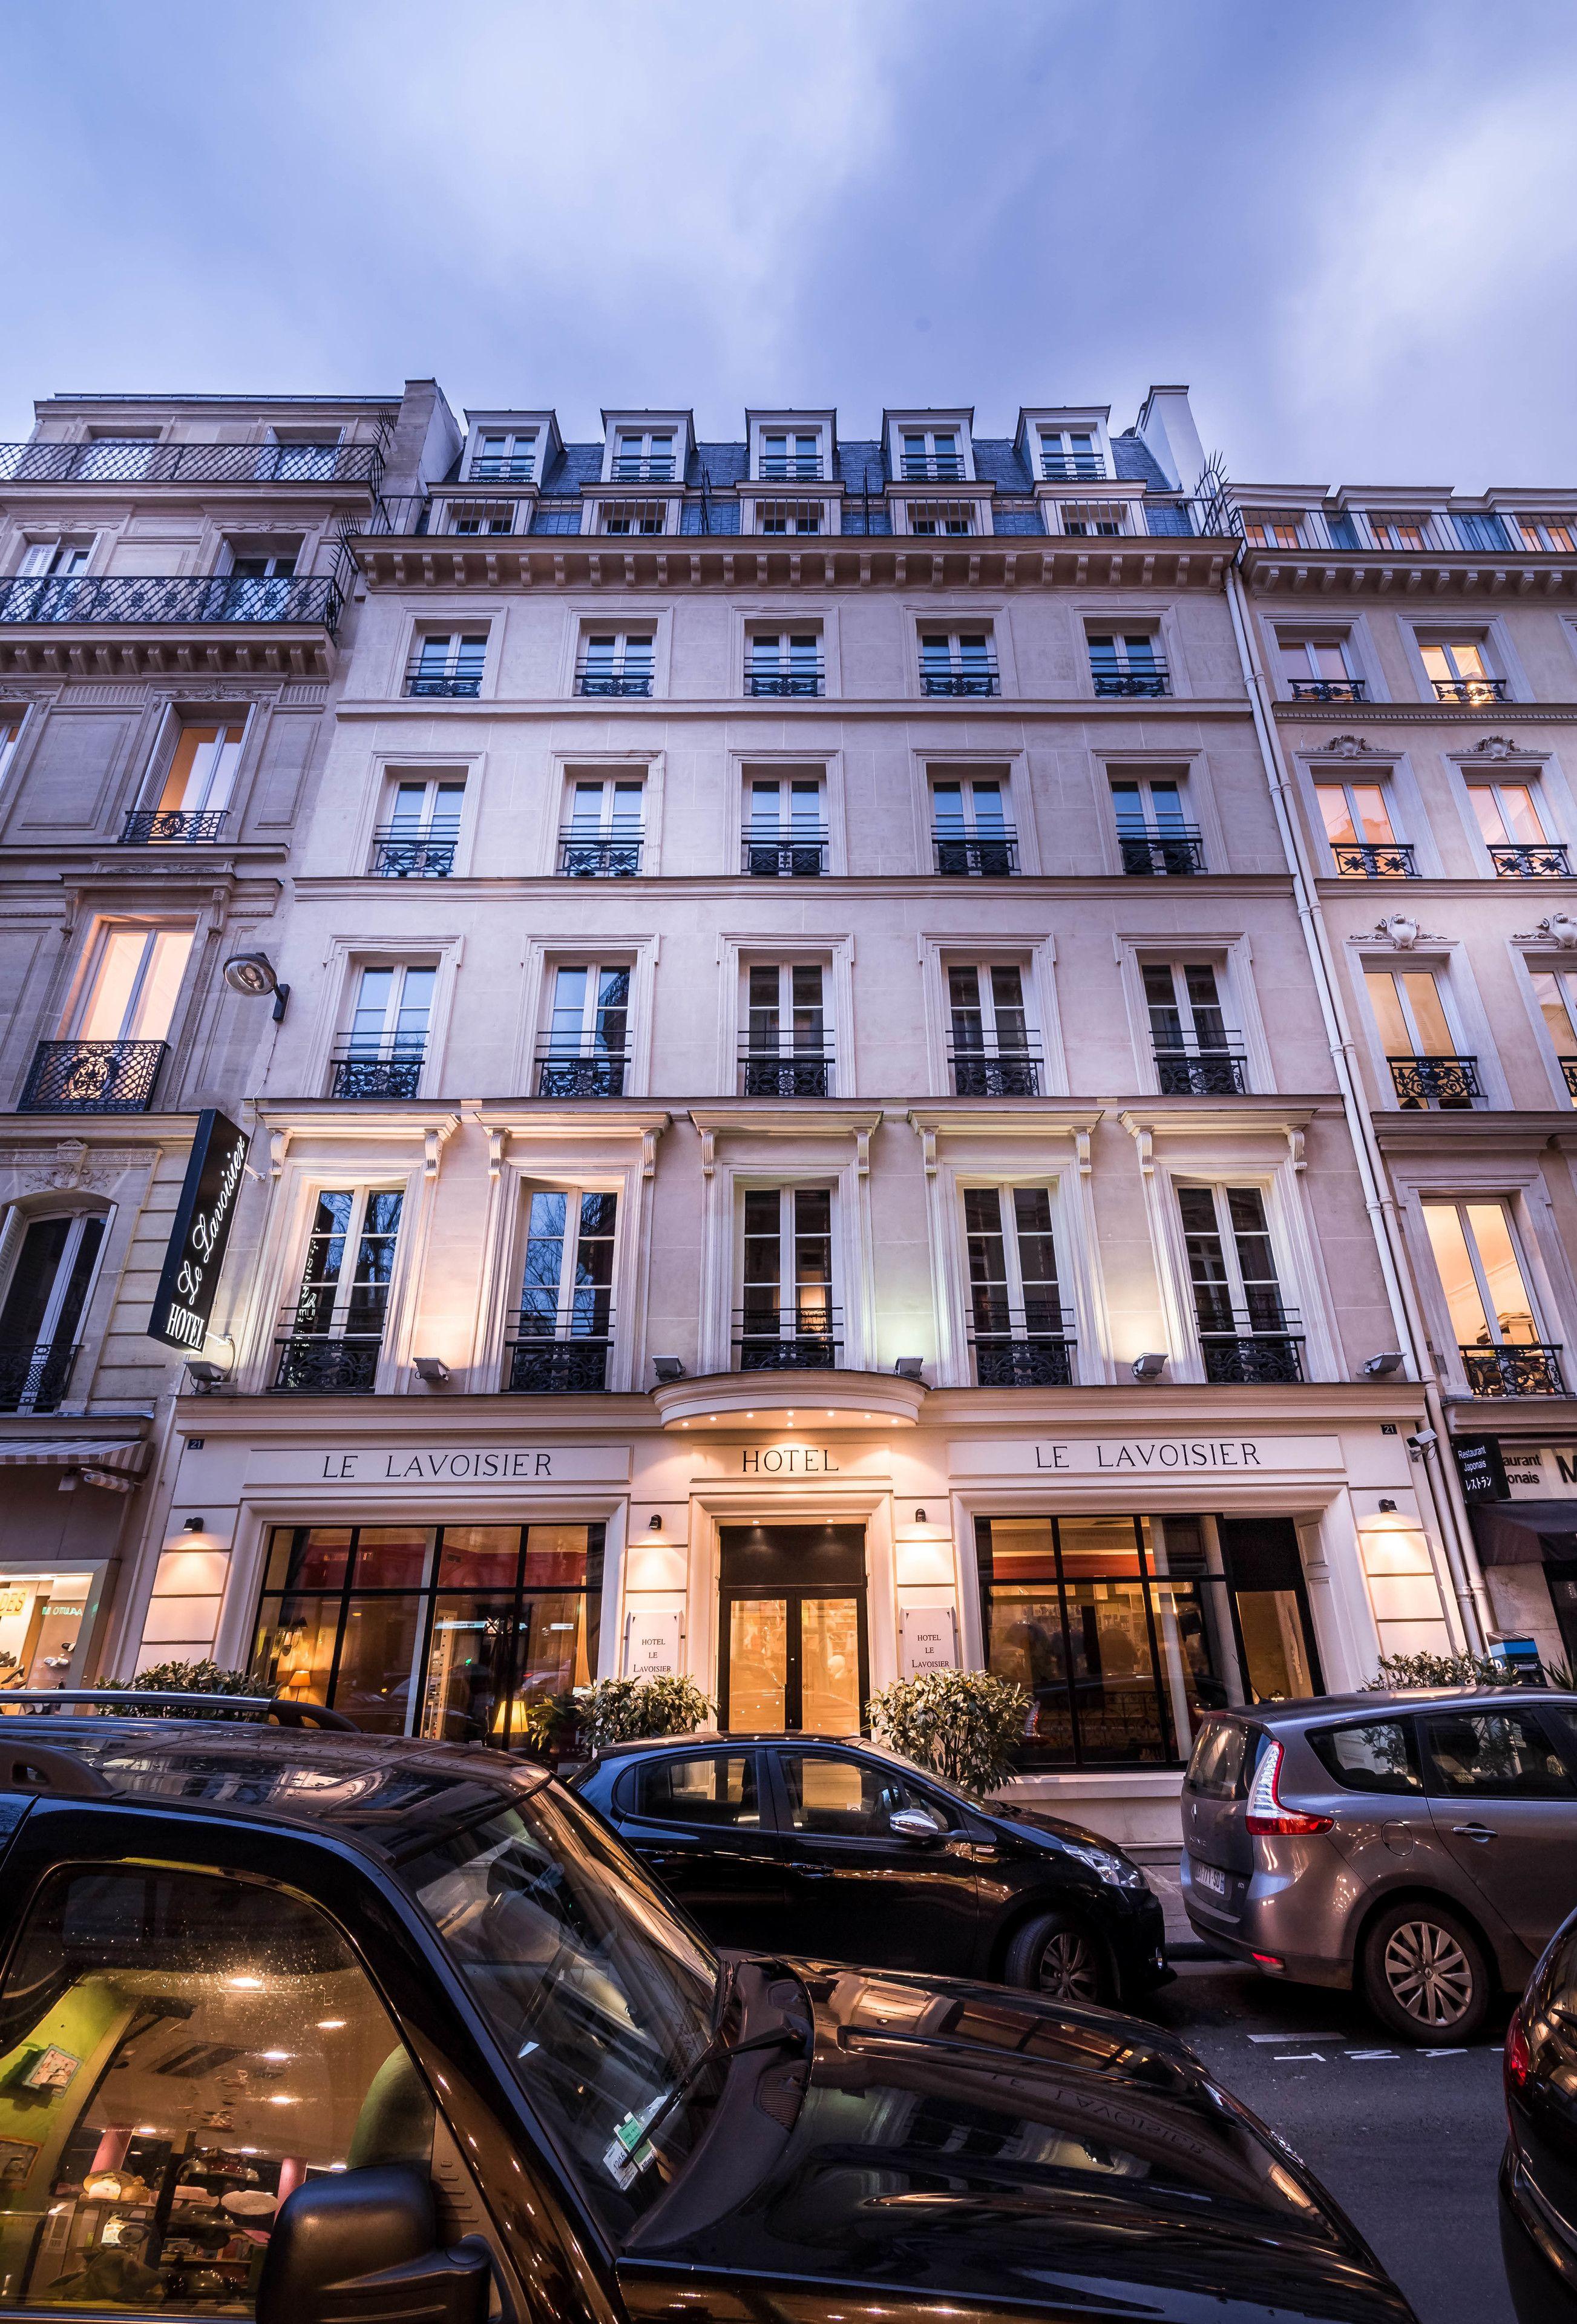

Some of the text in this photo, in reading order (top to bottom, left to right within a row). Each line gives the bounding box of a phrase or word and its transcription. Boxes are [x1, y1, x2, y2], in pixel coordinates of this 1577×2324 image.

[177, 1135, 244, 1305] Le Lavoisier
[165, 1303, 205, 1350] HOTEL
[1035, 1443, 1261, 1468] LE LAVOISIER
[1458, 1445, 1486, 1459] Restaurant
[322, 1454, 552, 1478] LE LAVOISIER
[743, 1449, 839, 1472] HOTEL
[1464, 1459, 1486, 1472] Japonais
[1502, 1454, 1542, 1466] aurant
[1465, 1476, 1492, 1491] レストラン
[1507, 1471, 1540, 1484] onais
[633, 1664, 672, 1673] LAVOISIER
[912, 1659, 949, 1668] LAVOISIER
